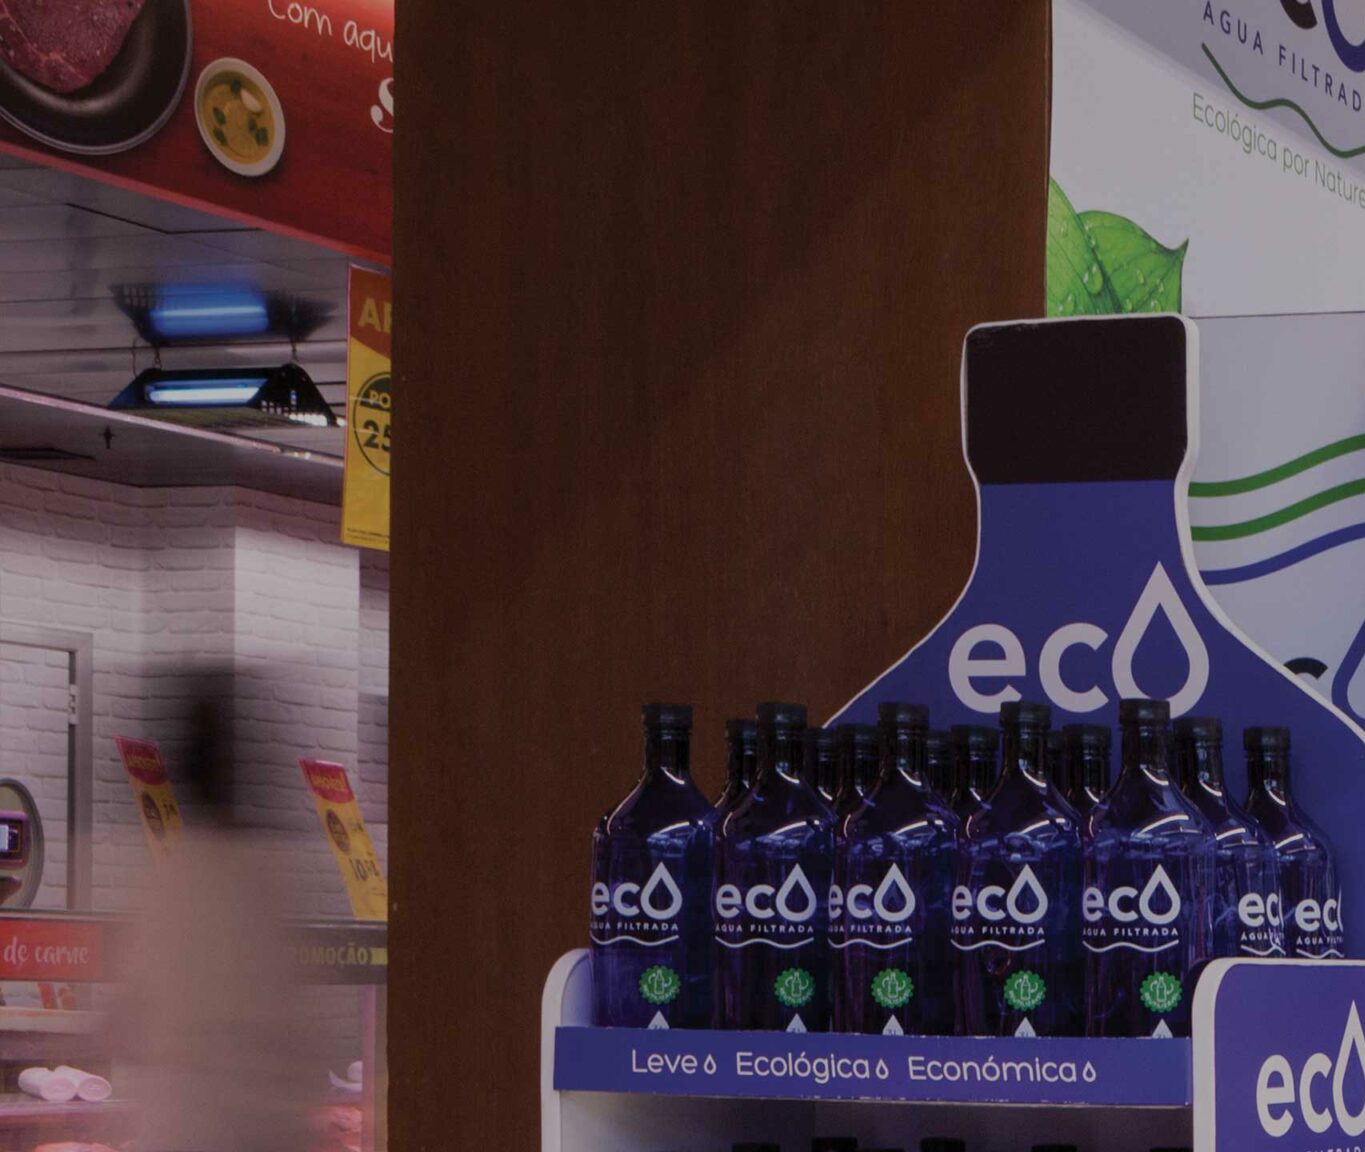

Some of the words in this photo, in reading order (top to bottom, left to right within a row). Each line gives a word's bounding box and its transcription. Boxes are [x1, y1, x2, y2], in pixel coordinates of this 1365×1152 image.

[1192, 91, 1278, 162] Ecológica
[1282, 145, 1310, 179] por
[750, 924, 815, 934] FILTRADA
[632, 1048, 698, 1075] Leve
[736, 1051, 870, 1084] Ecológica
[907, 1053, 1078, 1084] Económica
